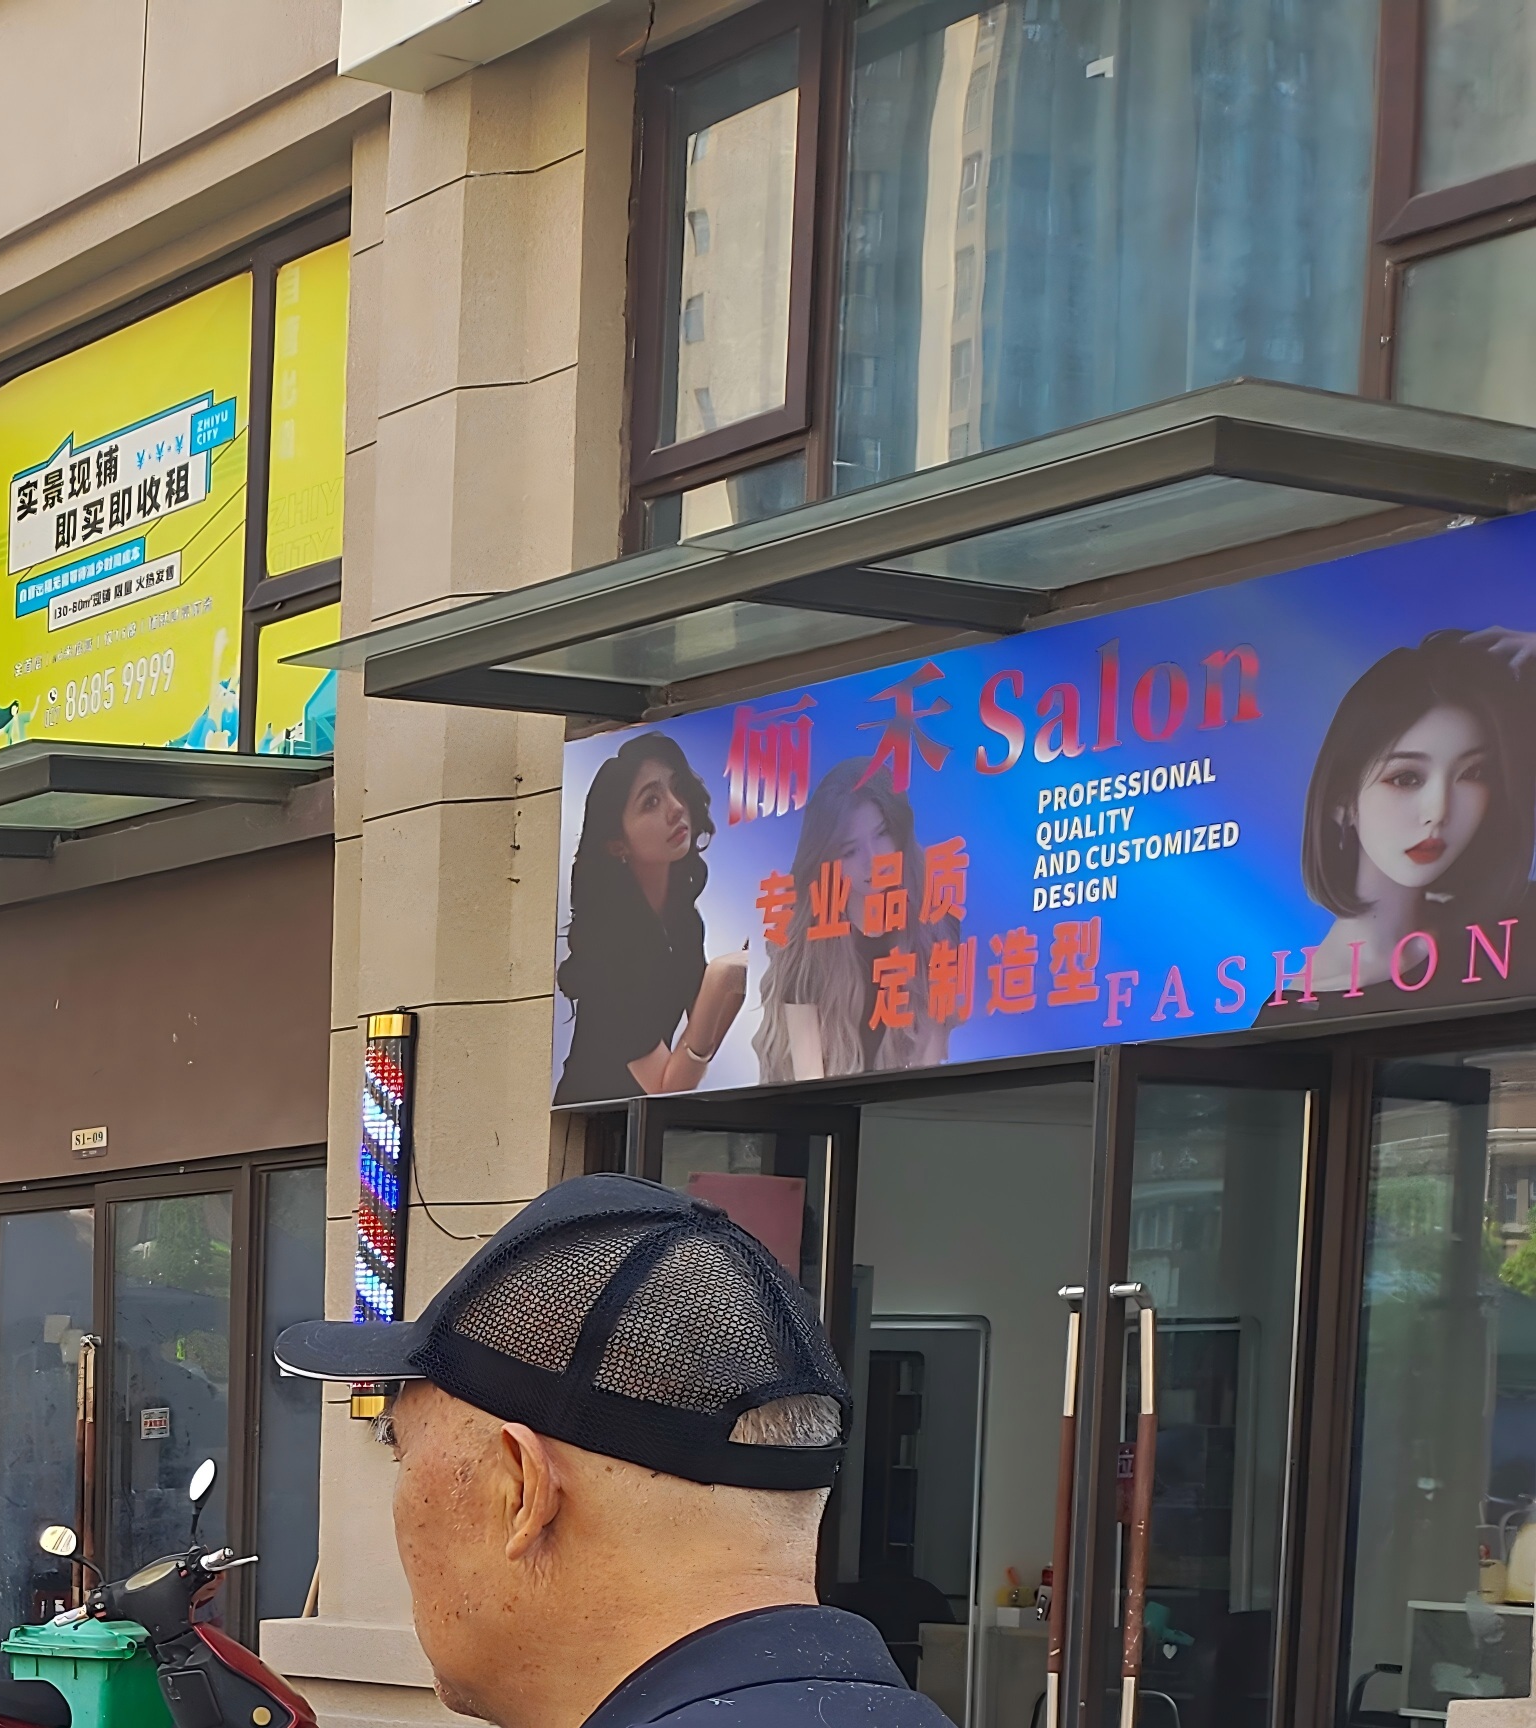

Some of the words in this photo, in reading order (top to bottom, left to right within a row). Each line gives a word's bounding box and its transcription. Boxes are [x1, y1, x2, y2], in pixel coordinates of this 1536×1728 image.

[196, 427, 219, 446] CITY
[16, 443, 120, 523] 实景现铺
[54, 461, 190, 552] 即买即收租
[65, 668, 116, 723] 8685
[121, 647, 176, 705] 9999
[974, 637, 1265, 777] Salon
[1037, 757, 1217, 816] PROFESSIONAL
[1034, 846, 1083, 882] AND
[1084, 820, 1240, 875] CUSTOMIZED
[1035, 806, 1135, 853] QUALITY
[753, 834, 971, 946] 专业品质
[1031, 876, 1119, 913] DESIGN
[868, 915, 1105, 1032] 定制造型
[1102, 917, 1519, 1030] FASHION
